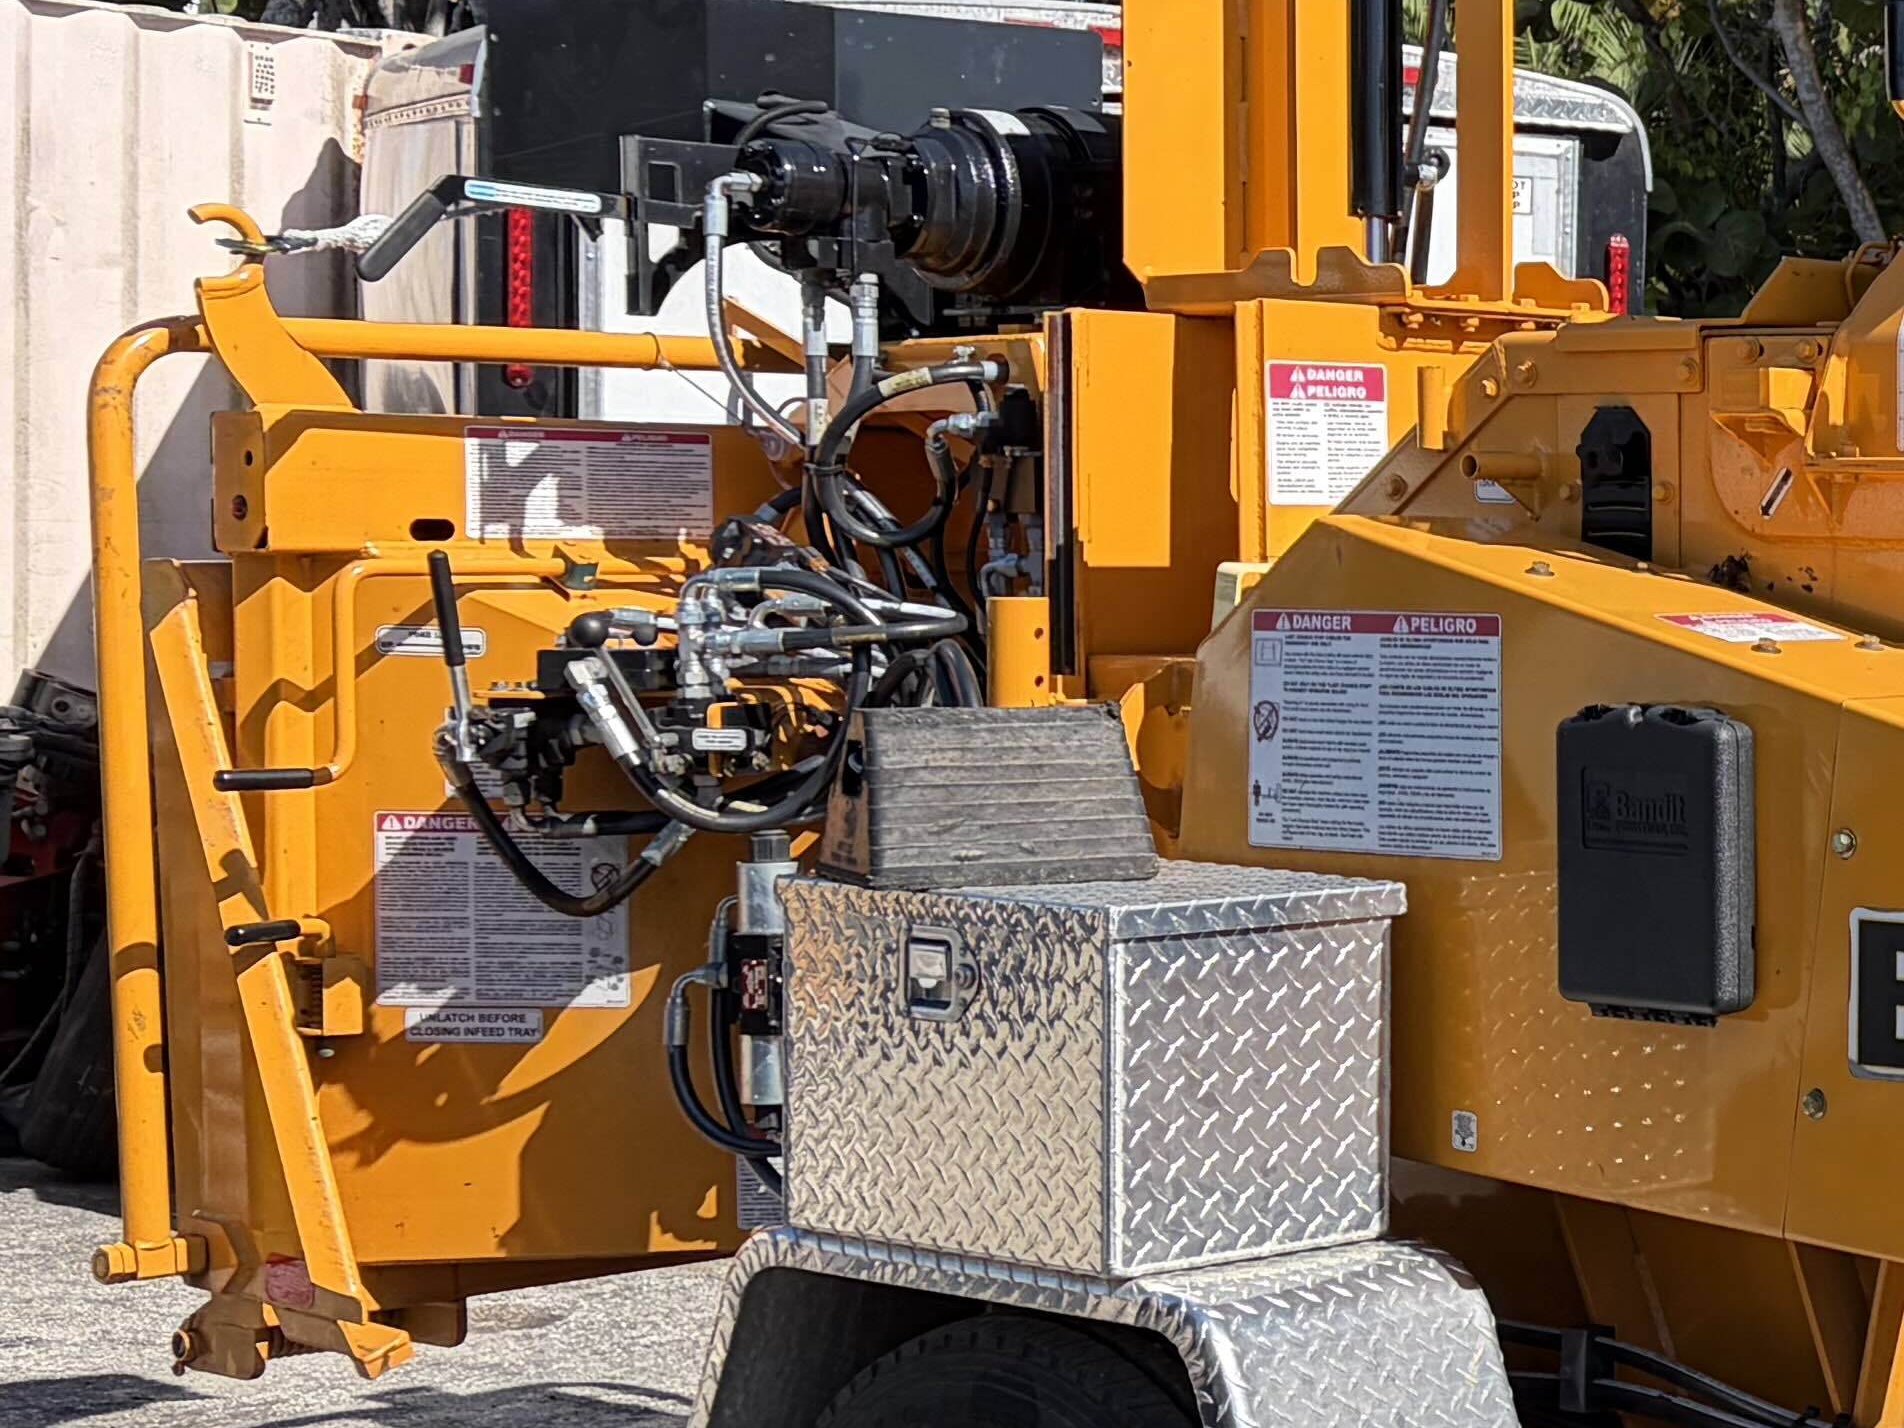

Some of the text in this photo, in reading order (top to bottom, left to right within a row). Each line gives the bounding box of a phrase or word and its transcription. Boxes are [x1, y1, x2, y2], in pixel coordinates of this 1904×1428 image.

[1306, 368, 1364, 382] DANGER
[1306, 385, 1367, 399] PELIGRO
[1293, 615, 1352, 630] DANGER
[1410, 617, 1477, 634] PELIGRO
[1616, 790, 1687, 823] Bandit
[403, 815, 478, 831] DANGER
[420, 1013, 527, 1023] UNLATCH BEFORE
[410, 1026, 537, 1037] CLOSING INFEED TRAY
